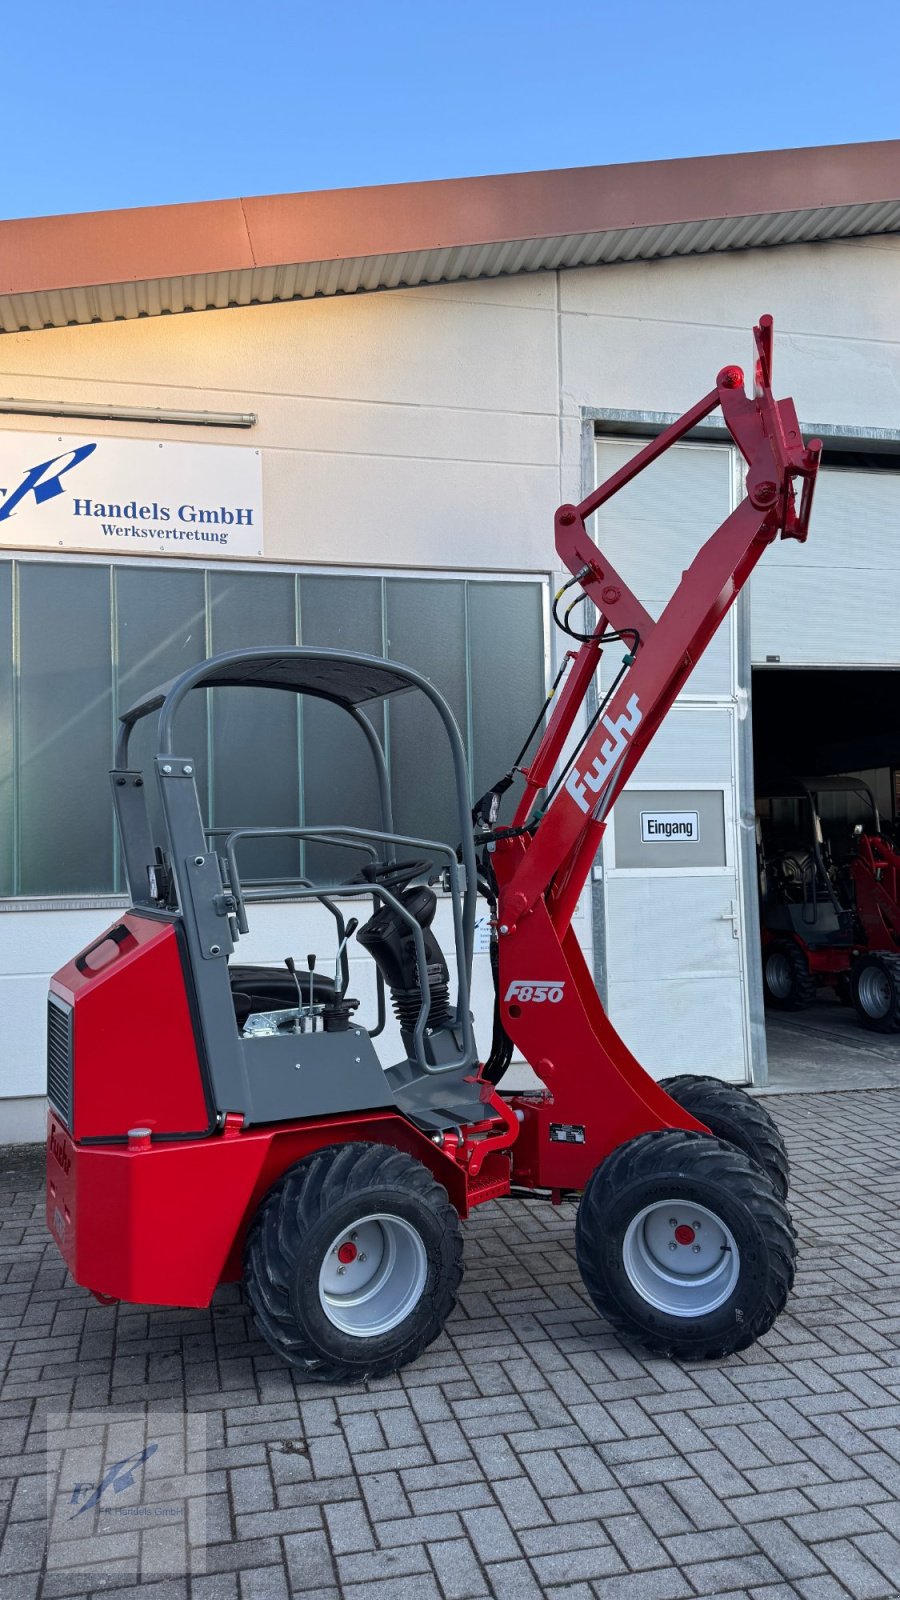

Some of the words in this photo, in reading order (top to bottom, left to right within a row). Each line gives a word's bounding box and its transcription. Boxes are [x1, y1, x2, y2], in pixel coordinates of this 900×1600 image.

[72, 498, 171, 521] Handels
[177, 504, 254, 526] GmbH
[101, 524, 229, 544] Werksvertretung
[564, 692, 643, 814] Fuchs
[647, 819, 693, 837] Eingang
[503, 980, 566, 1004] F850
